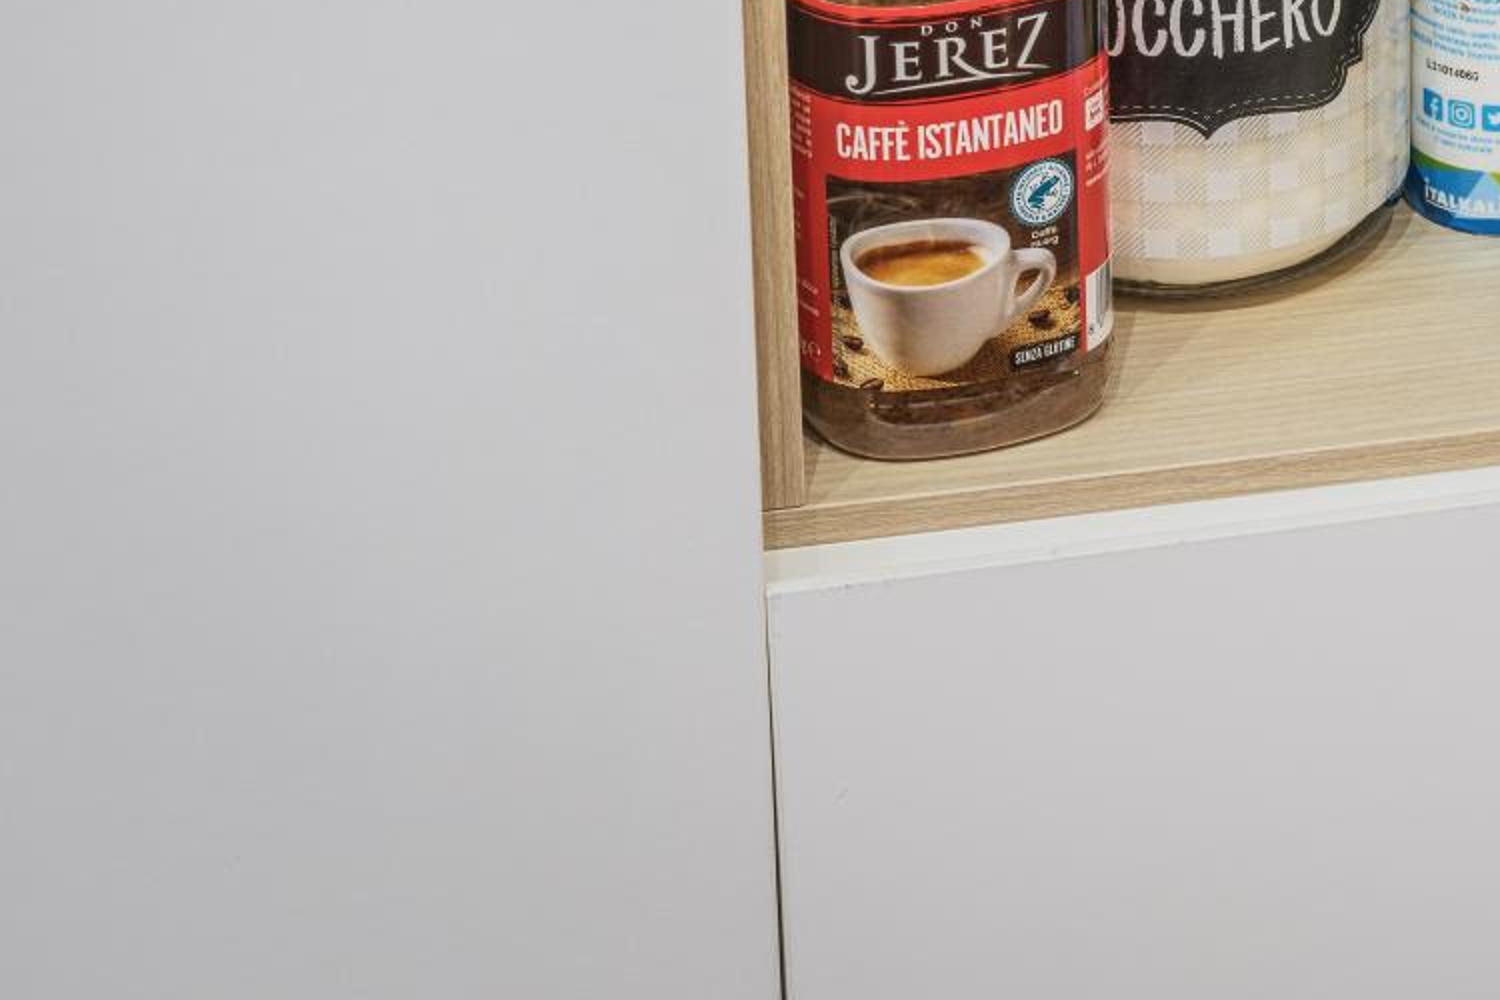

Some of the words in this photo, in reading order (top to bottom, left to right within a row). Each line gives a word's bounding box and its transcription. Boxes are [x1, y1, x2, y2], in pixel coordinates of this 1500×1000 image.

[921, 16, 983, 37] DON
[845, 11, 1054, 96] JEREZ
[836, 120, 912, 162] CAFFÈ
[917, 99, 1064, 160] ISTANTANEO
[1014, 346, 1043, 366] SENZA
[1043, 335, 1077, 358] GLUTINE
